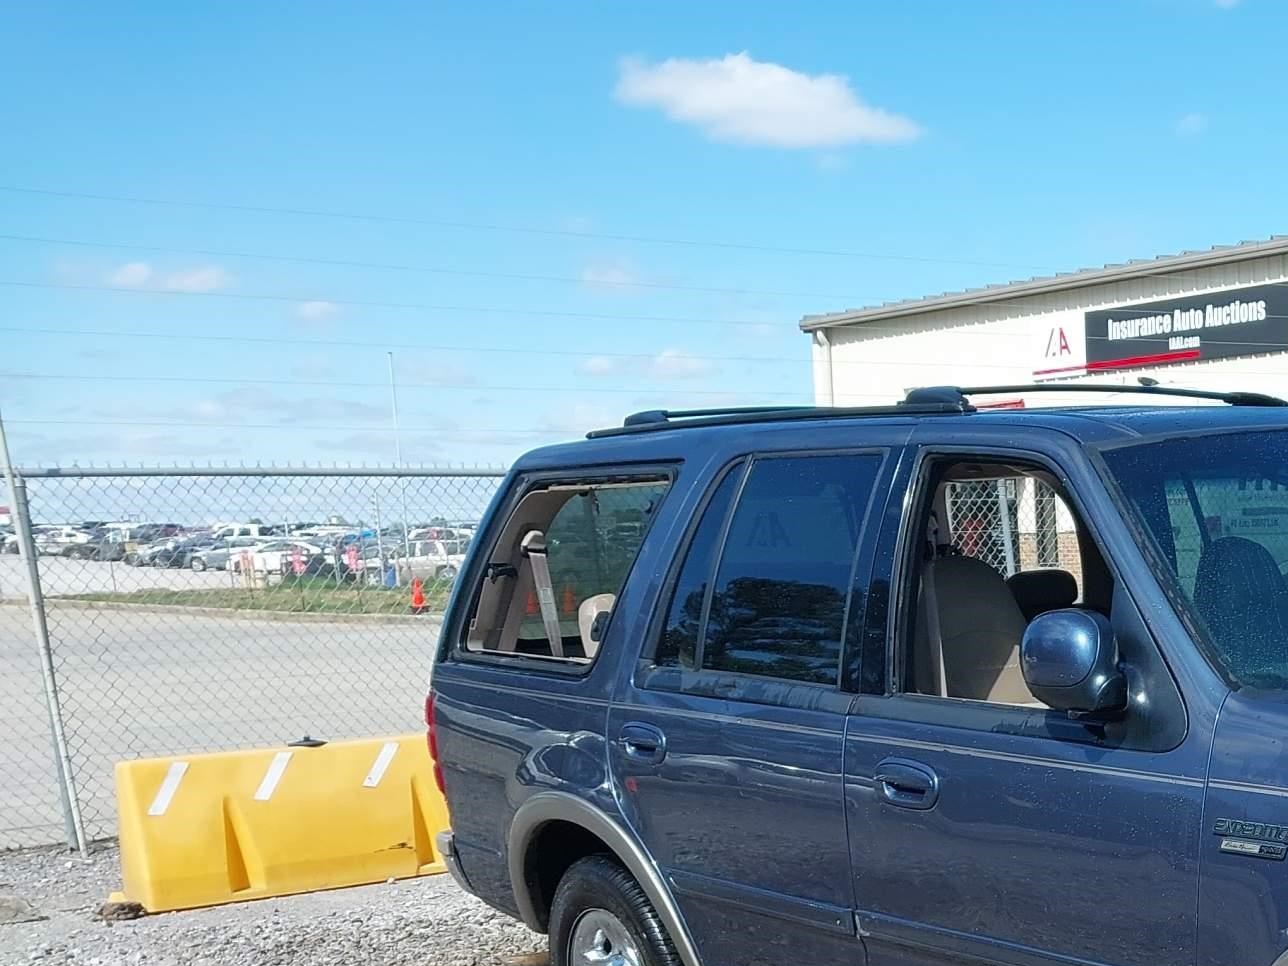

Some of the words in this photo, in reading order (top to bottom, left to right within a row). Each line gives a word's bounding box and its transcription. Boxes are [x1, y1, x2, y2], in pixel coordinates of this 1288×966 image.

[1108, 316, 1171, 341] Insurance
[1173, 308, 1203, 332] Auto
[1205, 300, 1266, 327] Auctions
